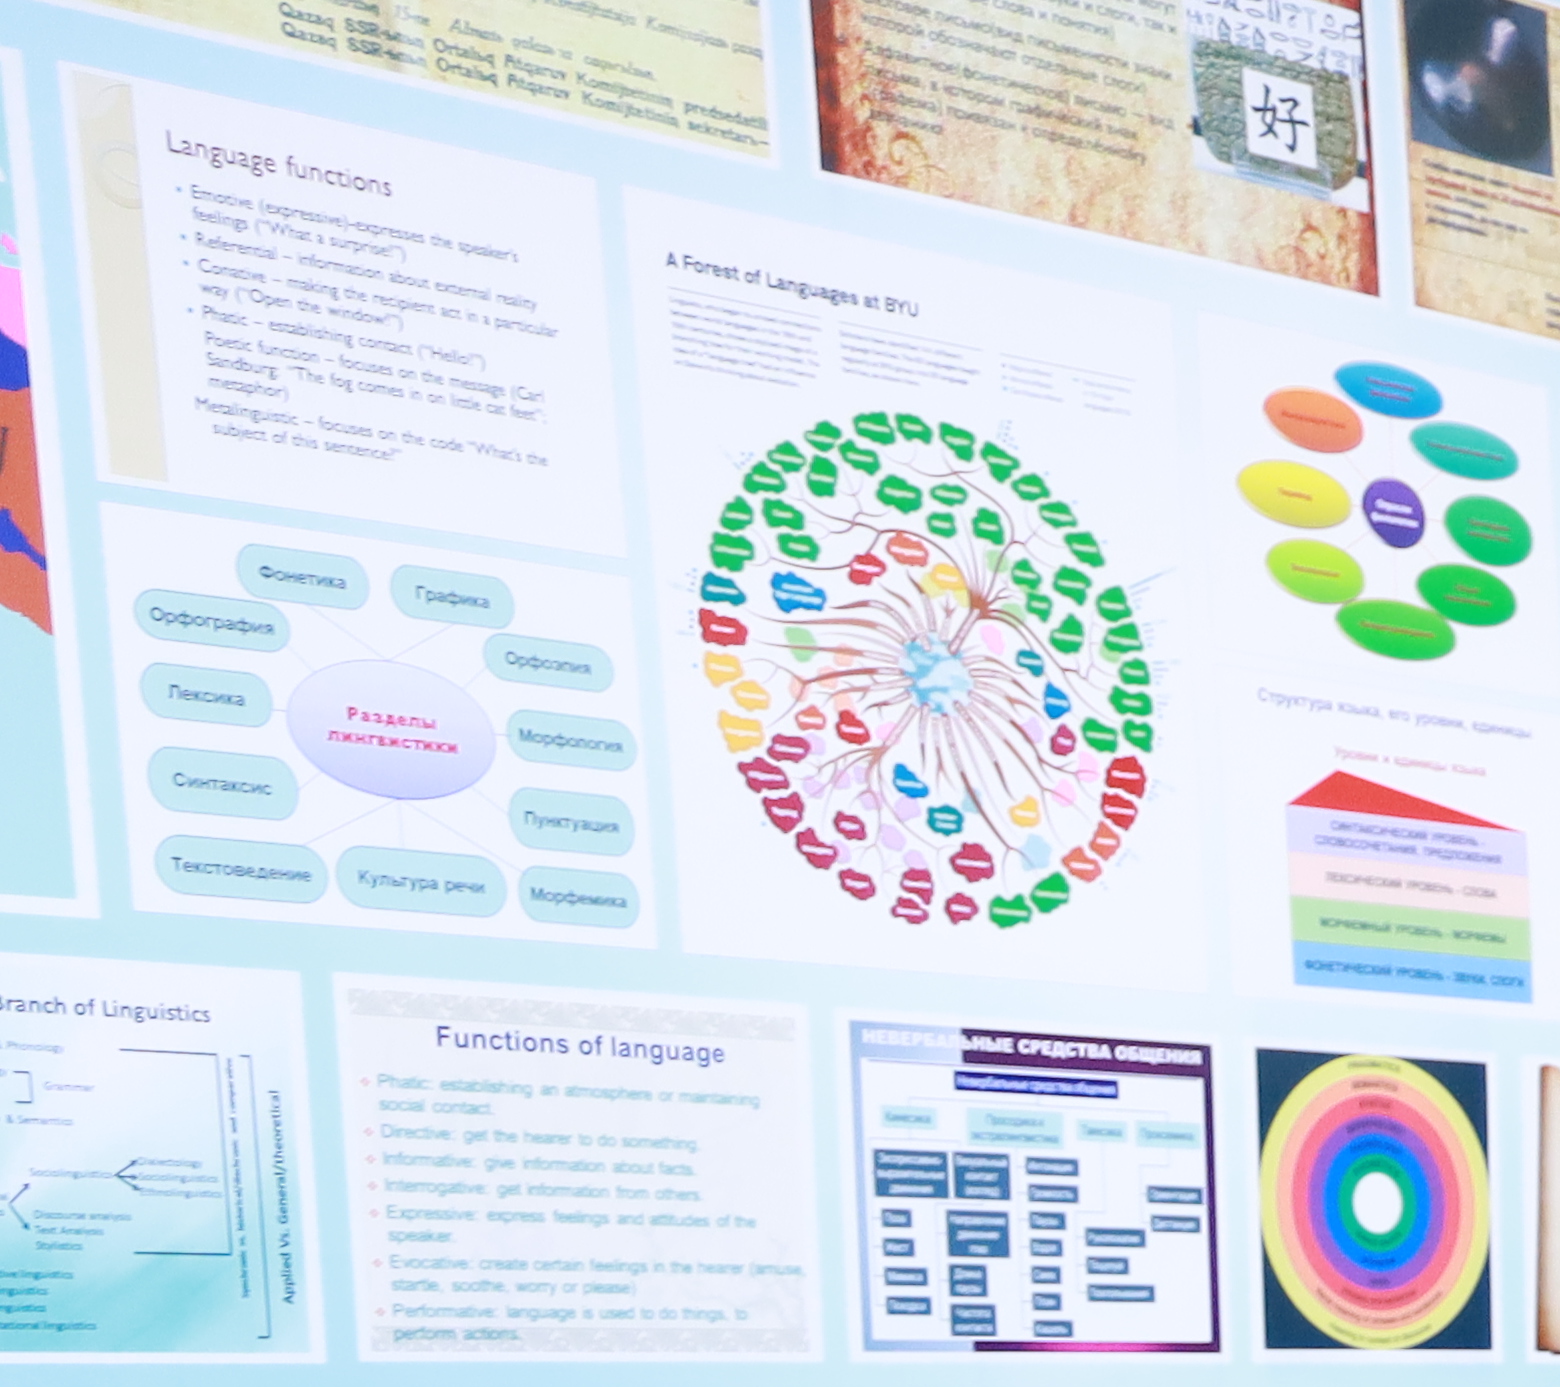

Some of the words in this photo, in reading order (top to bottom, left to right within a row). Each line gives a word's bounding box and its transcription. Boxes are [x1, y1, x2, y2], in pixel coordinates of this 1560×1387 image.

[1250, 83, 1310, 153] 好
[166, 130, 277, 177] Language
[286, 154, 393, 197] functions
[191, 184, 253, 209] Emotive
[430, 234, 453, 249] the
[192, 206, 248, 232] feelings
[316, 234, 325, 244] a
[195, 232, 278, 260] Referential
[299, 254, 383, 279] information
[389, 271, 431, 289] about
[434, 282, 491, 300] external
[496, 294, 537, 314] reality
[666, 251, 679, 268] A
[683, 254, 740, 281] Forest
[744, 269, 762, 285] of
[766, 271, 859, 306] Languages
[864, 295, 880, 310] at
[885, 296, 920, 318] BYU
[199, 283, 229, 300] way
[298, 300, 322, 314] the
[286, 278, 341, 301] making
[344, 286, 368, 302] the
[483, 315, 491, 326] a
[268, 321, 354, 349] establishing
[359, 337, 414, 356] contact
[257, 340, 320, 363] function
[339, 354, 394, 376] focuses
[398, 369, 418, 379] on
[421, 371, 445, 385] the
[449, 377, 506, 399] message
[258, 565, 347, 590] Фонетика
[415, 584, 491, 609] Графика
[149, 606, 276, 636] Орфография
[505, 651, 592, 675] Орфоэпия
[168, 683, 247, 707] Лексика
[346, 706, 438, 730] Разделы
[1257, 687, 1333, 712] Структура
[1389, 709, 1410, 722] его
[1472, 720, 1532, 739] единицы
[327, 729, 460, 755] лингвистики
[518, 727, 625, 753] Морфология
[172, 772, 274, 796] Синтаксис
[523, 810, 620, 834] Пунктуация
[170, 856, 313, 883] Текстоведение
[357, 870, 439, 892] Культура
[444, 879, 487, 895] речи
[529, 886, 628, 909] Морфемика
[73, 998, 96, 1016] of
[102, 1000, 211, 1024] Linguistics
[436, 1026, 570, 1054] Functions
[578, 1035, 603, 1056] of
[611, 1036, 725, 1068] language
[861, 1027, 1014, 1056] НЕВЕРБАЛЬНЫЕ
[1017, 1037, 1112, 1061] СРЕДСТВА
[1114, 1044, 1203, 1066] ОБЩЕНИЯ
[440, 1080, 533, 1098] establishing
[540, 1085, 558, 1096] an
[658, 1091, 674, 1102] or
[379, 1100, 425, 1112] social
[281, 1252, 295, 1304] Applied
